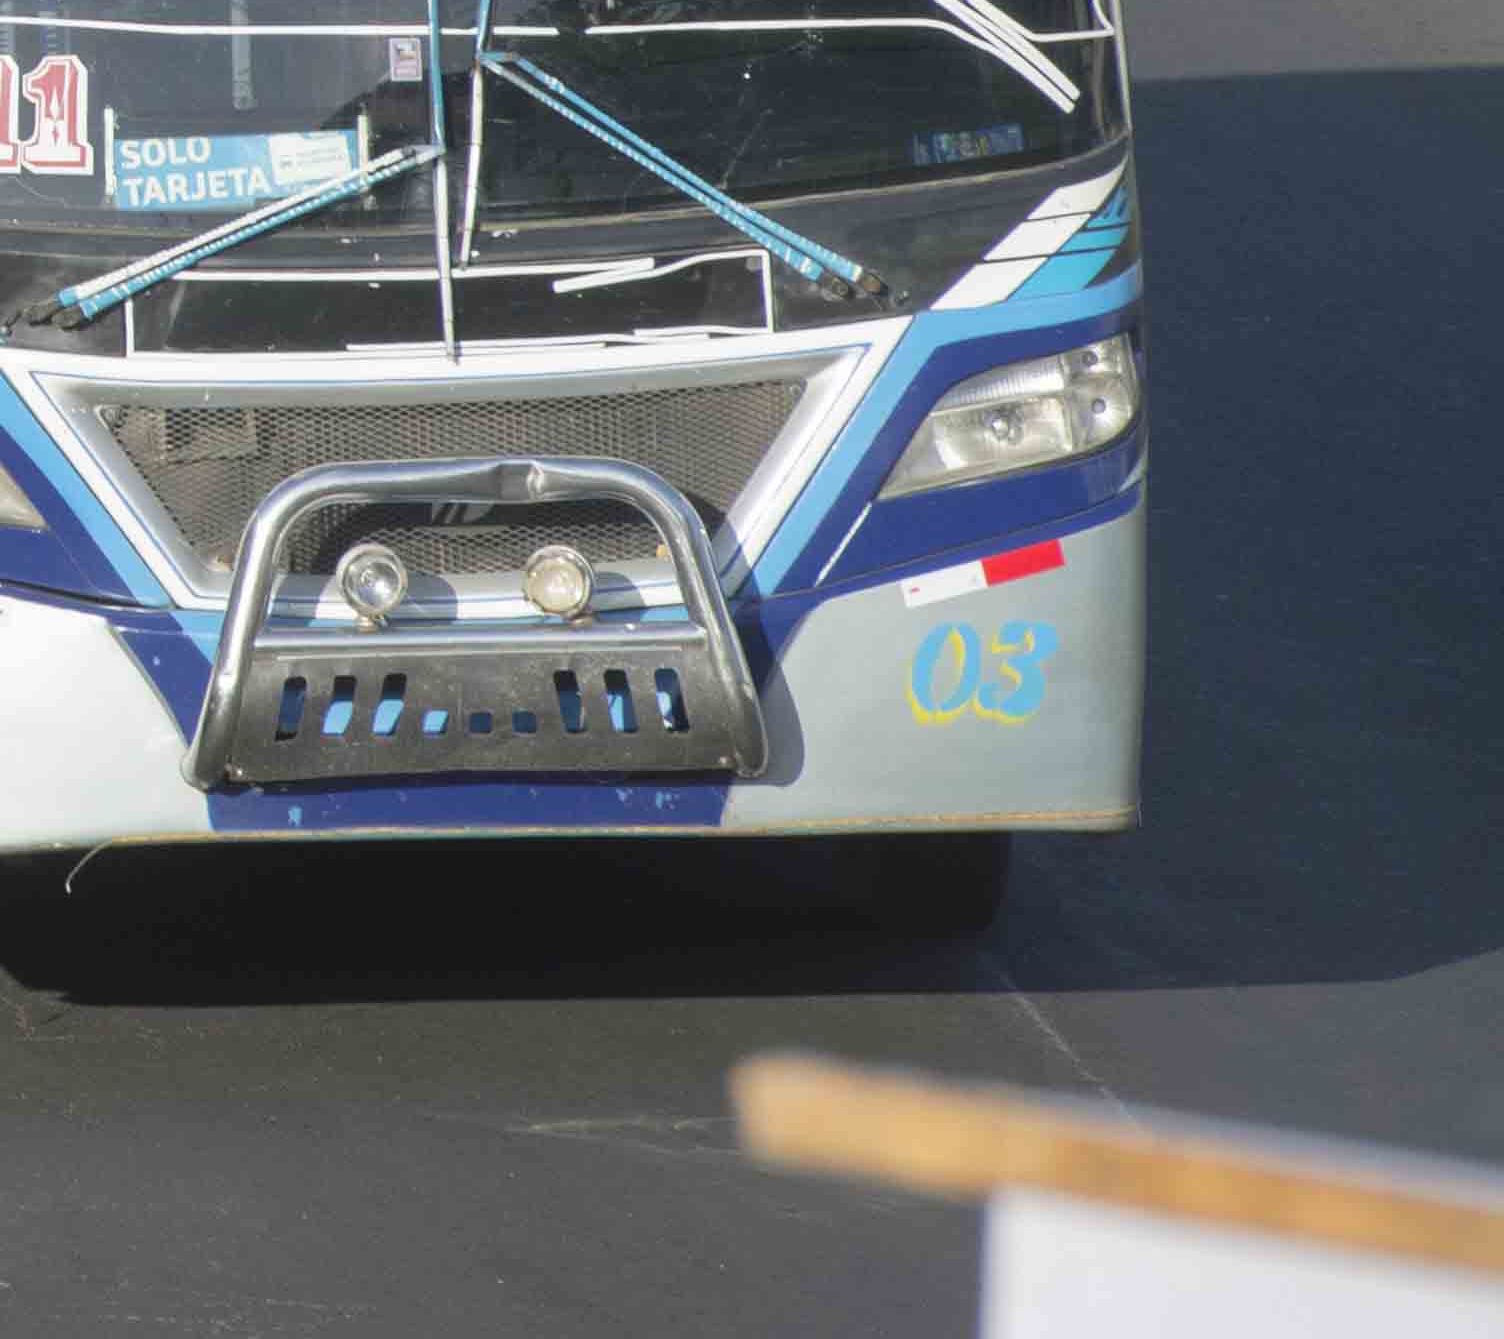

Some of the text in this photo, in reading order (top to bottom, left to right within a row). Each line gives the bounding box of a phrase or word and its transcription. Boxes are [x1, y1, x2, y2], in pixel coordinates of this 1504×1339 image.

[119, 136, 212, 170] SOLO
[122, 166, 272, 207] TARJETA
[904, 620, 1059, 725] 03
